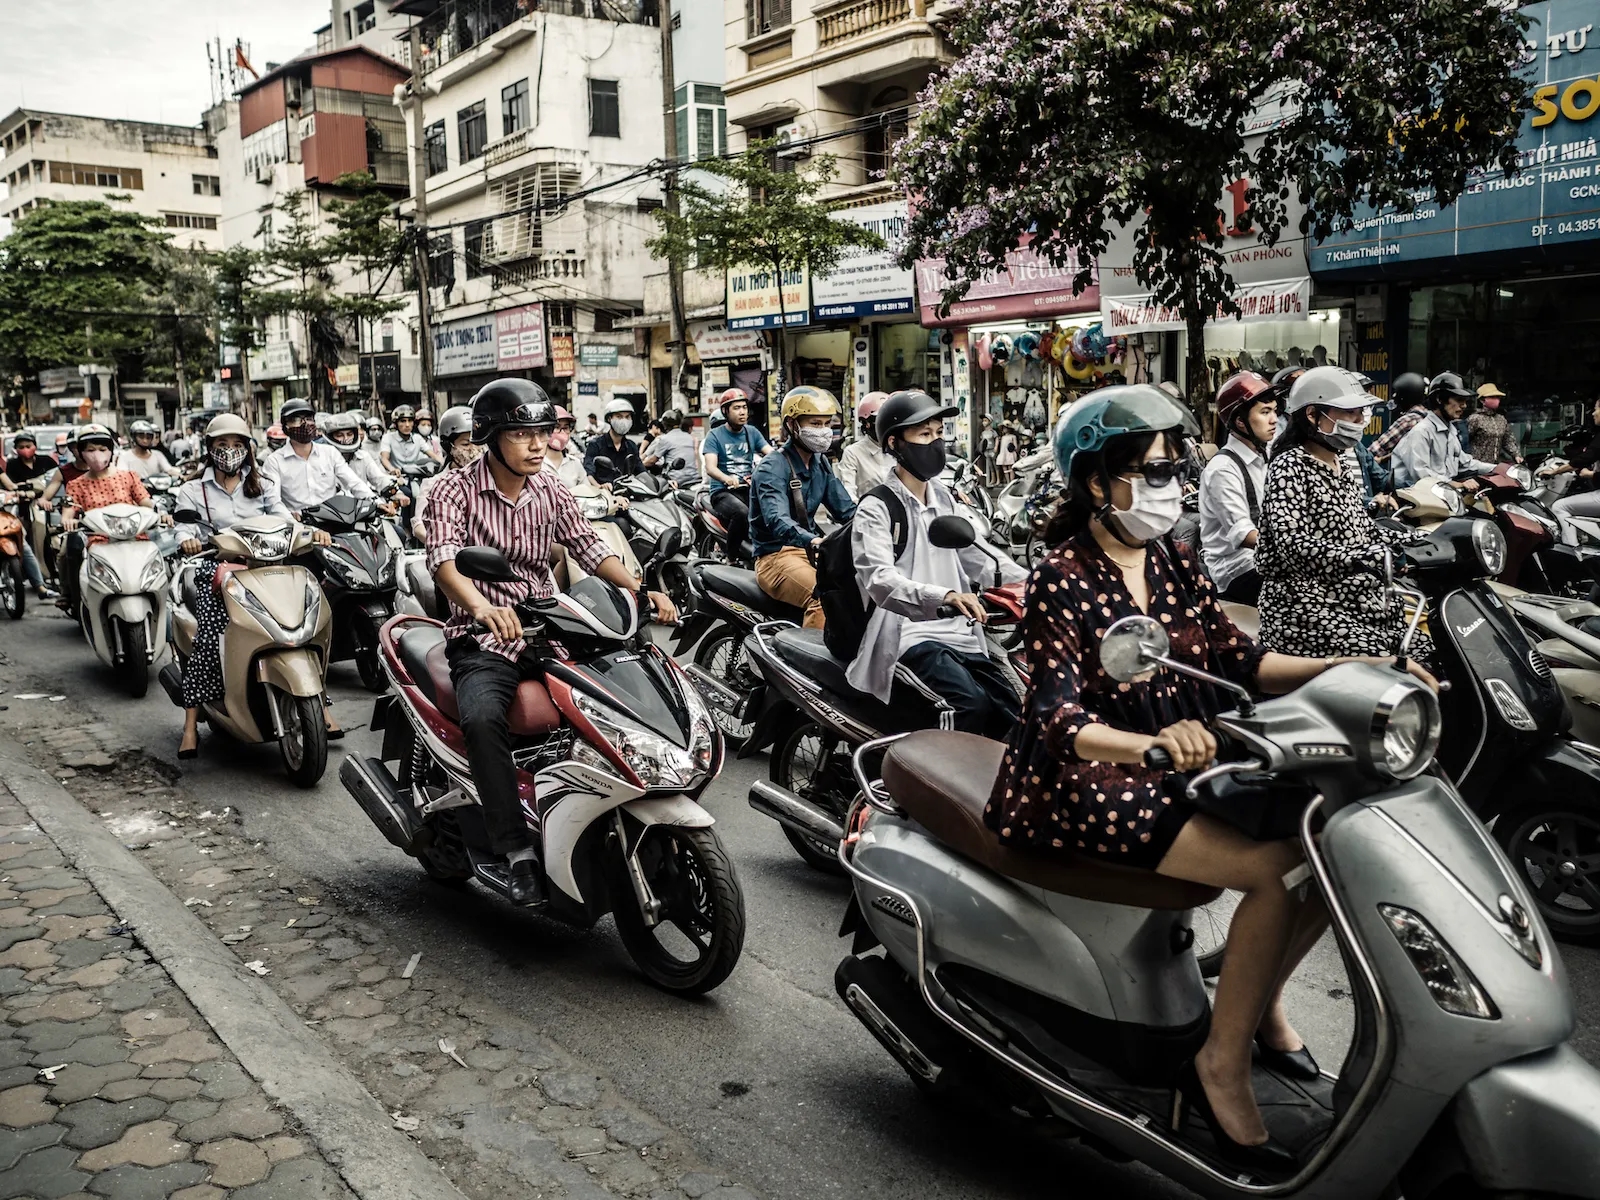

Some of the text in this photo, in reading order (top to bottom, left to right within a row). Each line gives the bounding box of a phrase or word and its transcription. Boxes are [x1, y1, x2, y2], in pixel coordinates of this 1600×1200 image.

[1526, 142, 1558, 166] TỐT
[1561, 137, 1597, 160] NHÀ
[1487, 172, 1535, 193] THUỐC
[1541, 166, 1590, 184] THÀNH
[1532, 224, 1553, 237] ĐT:
[1253, 246, 1293, 260] PHÒNG
[1326, 251, 1333, 263] 7
[1386, 243, 1400, 255] HN
[1259, 290, 1276, 315] GIÁ
[1279, 292, 1302, 314] 10%
[1362, 347, 1389, 371] THUỐC
[1456, 617, 1486, 638] Vespa
[581, 772, 613, 790] HONDA
